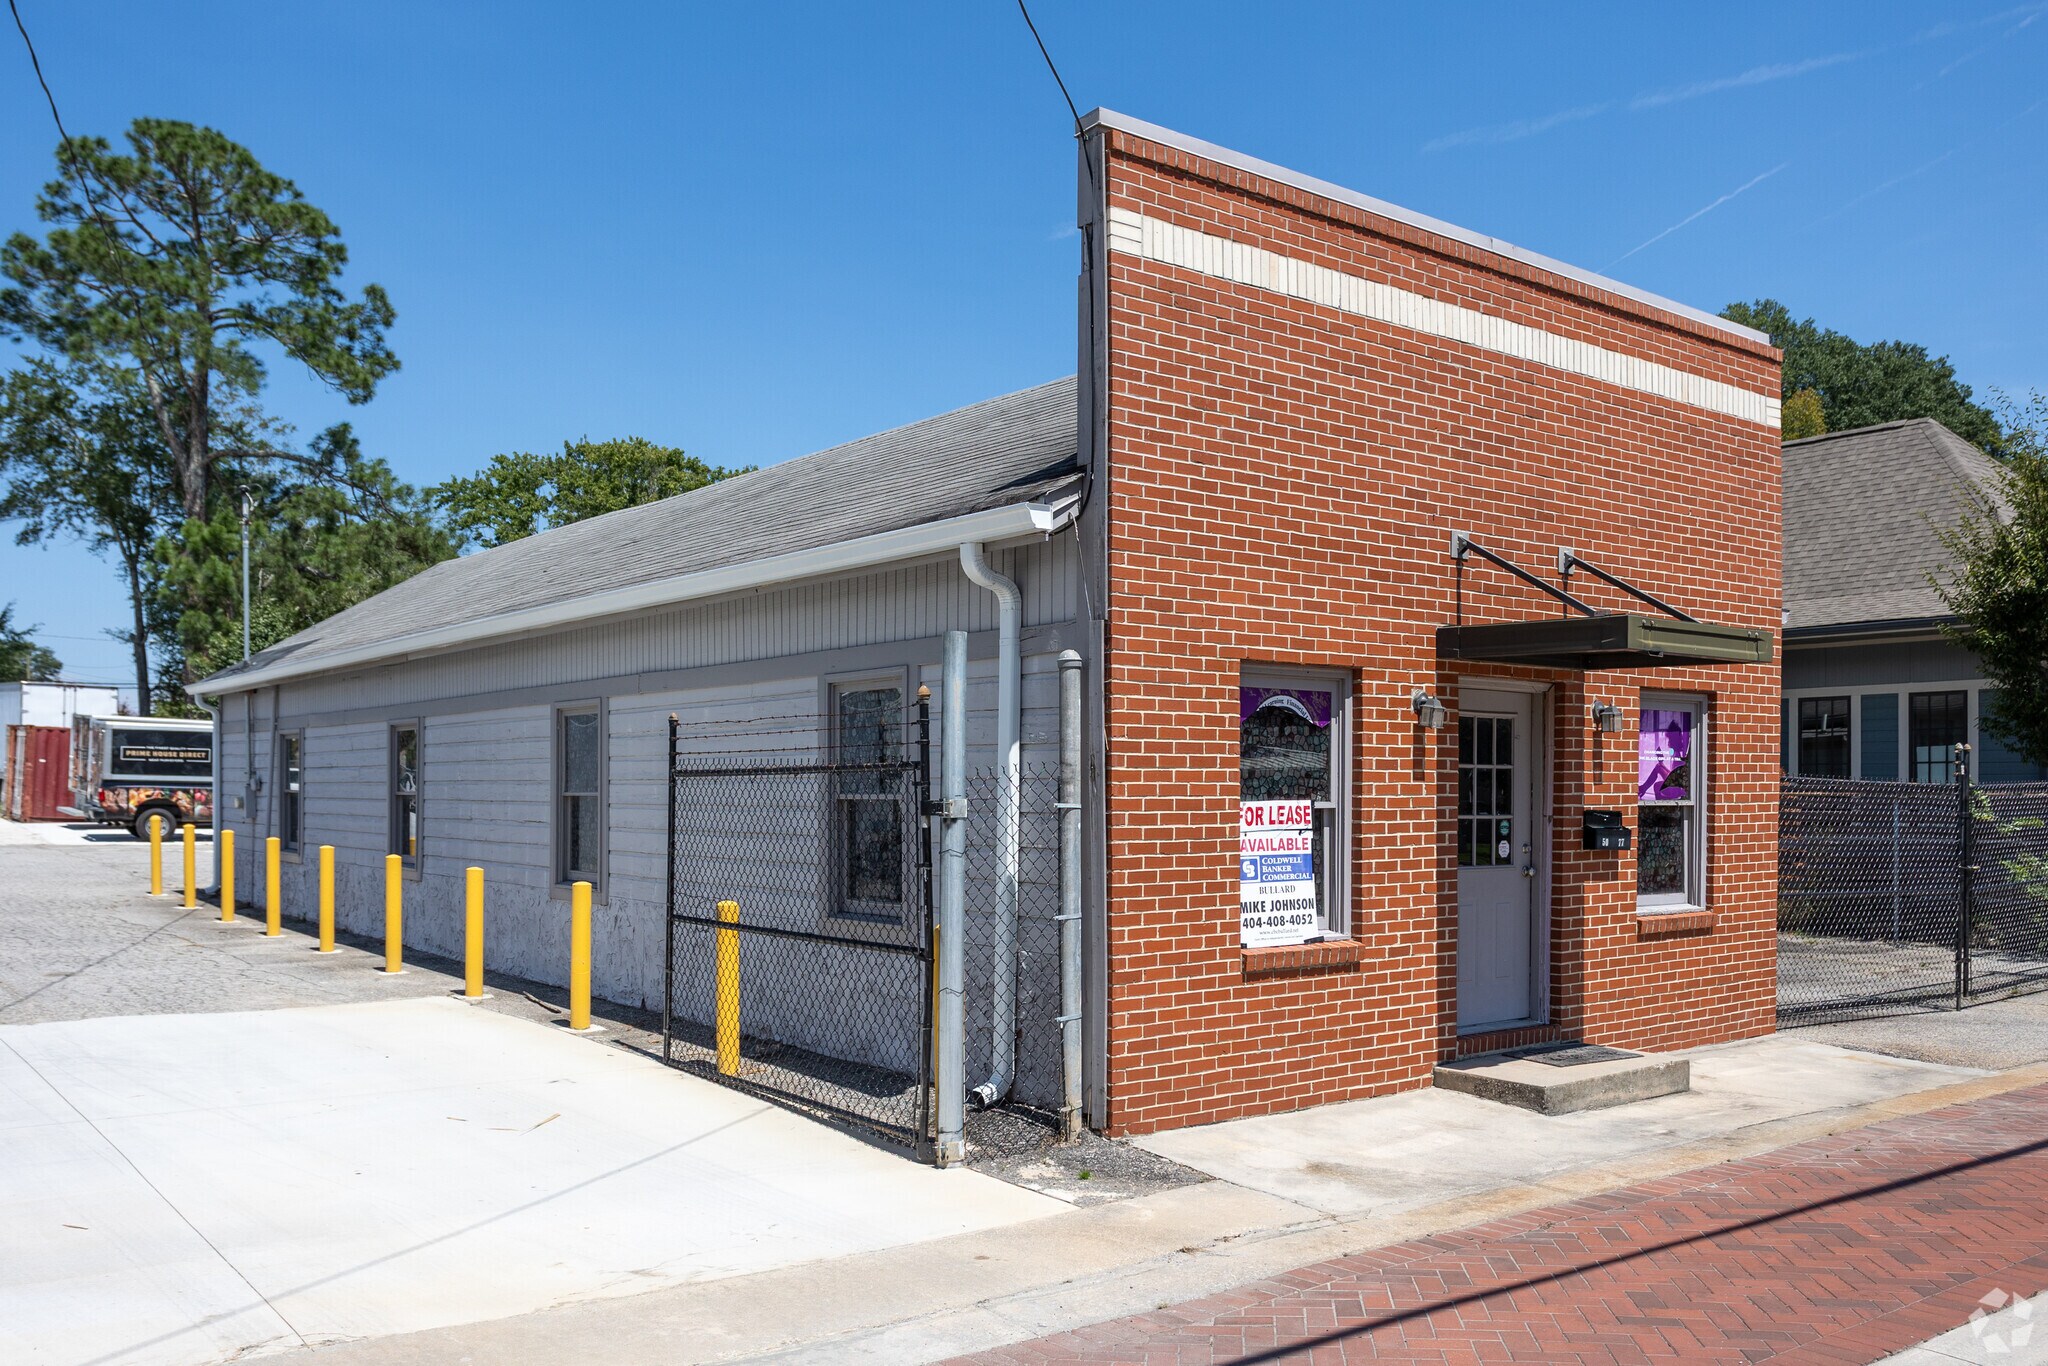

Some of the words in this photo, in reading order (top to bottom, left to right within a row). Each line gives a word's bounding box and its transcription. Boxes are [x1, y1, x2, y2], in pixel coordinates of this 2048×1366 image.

[1286, 699, 1307, 717] Financial
[152, 750, 177, 758] HOUSE
[1268, 805, 1311, 826] LEASE
[1240, 837, 1309, 853] AVAILABLE
[1601, 837, 1609, 847] 50
[1618, 838, 1625, 847] 77
[1262, 856, 1303, 865] COLDWELL
[1262, 865, 1292, 873] BANKER
[1262, 872, 1312, 882] COMMERCIAL
[1259, 885, 1296, 895] BULLARD
[1240, 900, 1266, 914] MIKE
[1270, 897, 1315, 912] JOHNSON
[1242, 913, 1313, 929] 404-408-4052
